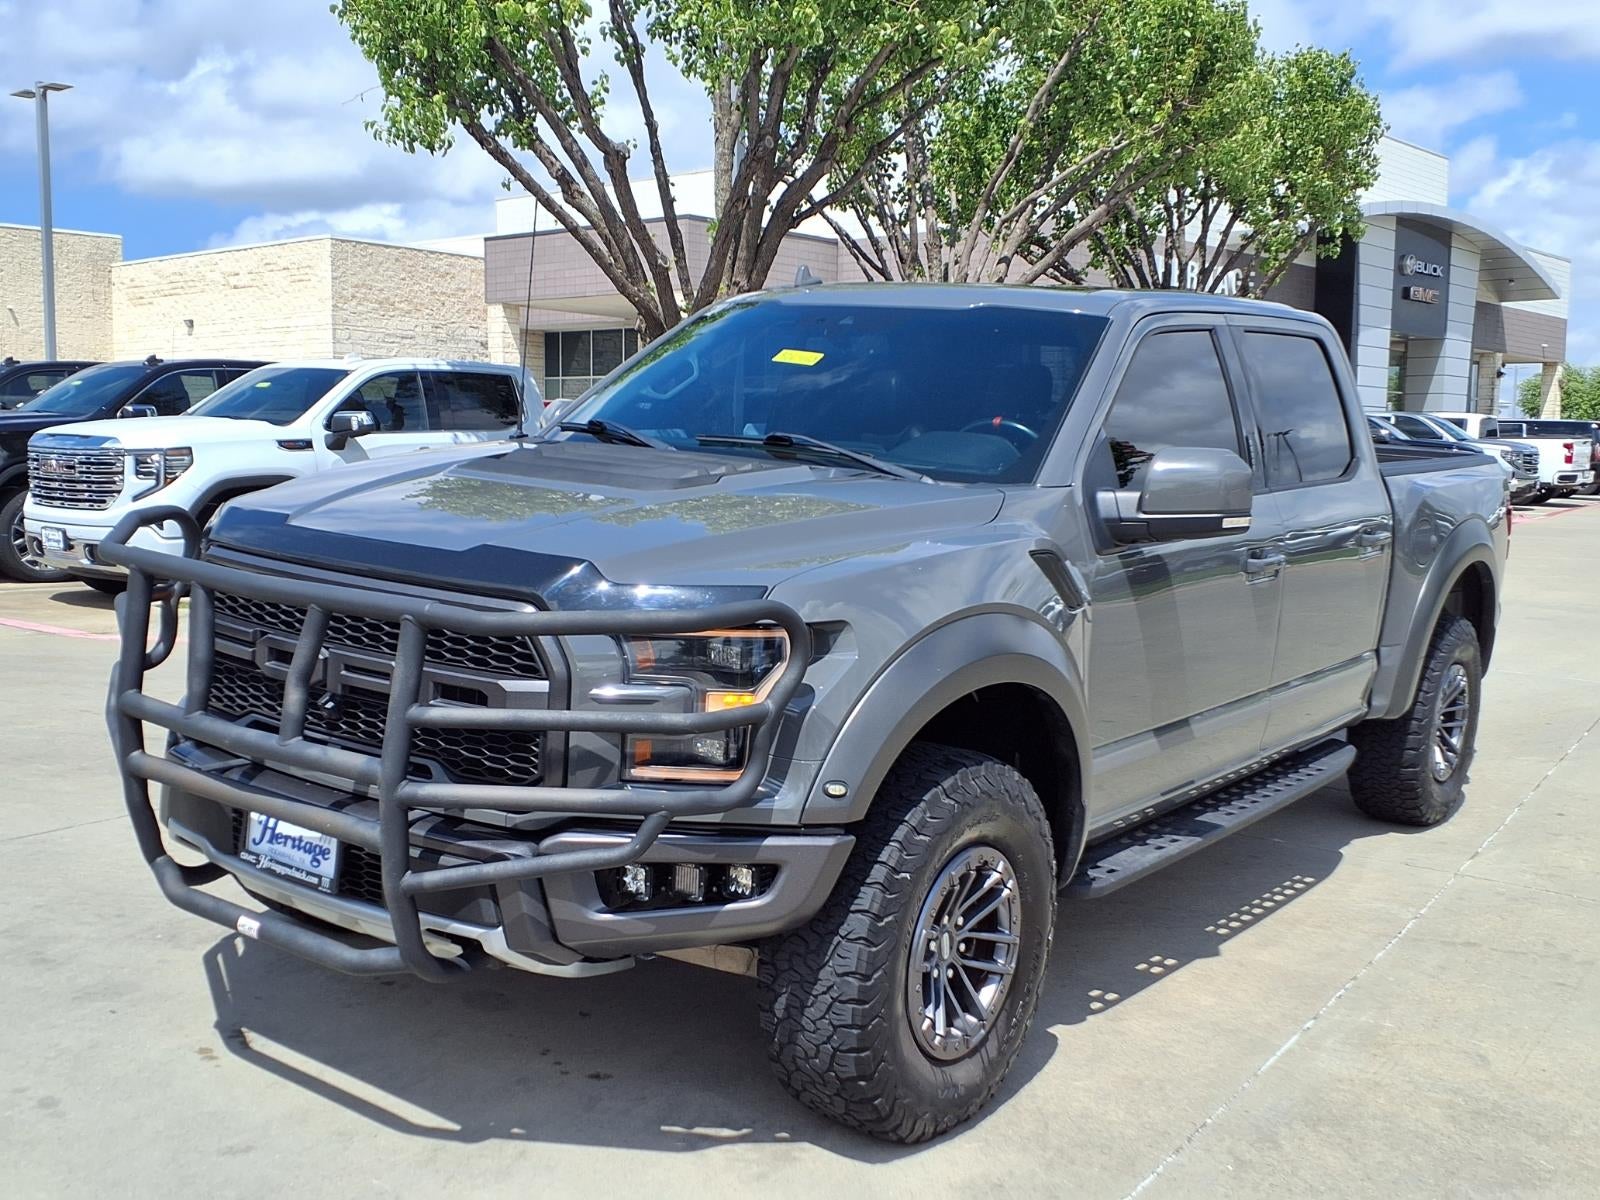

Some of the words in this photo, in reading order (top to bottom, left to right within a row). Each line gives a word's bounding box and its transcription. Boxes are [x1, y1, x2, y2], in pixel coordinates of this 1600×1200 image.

[1416, 260, 1444, 277] BUICK
[1410, 286, 1440, 304] GMC
[252, 815, 332, 868] Heritage
